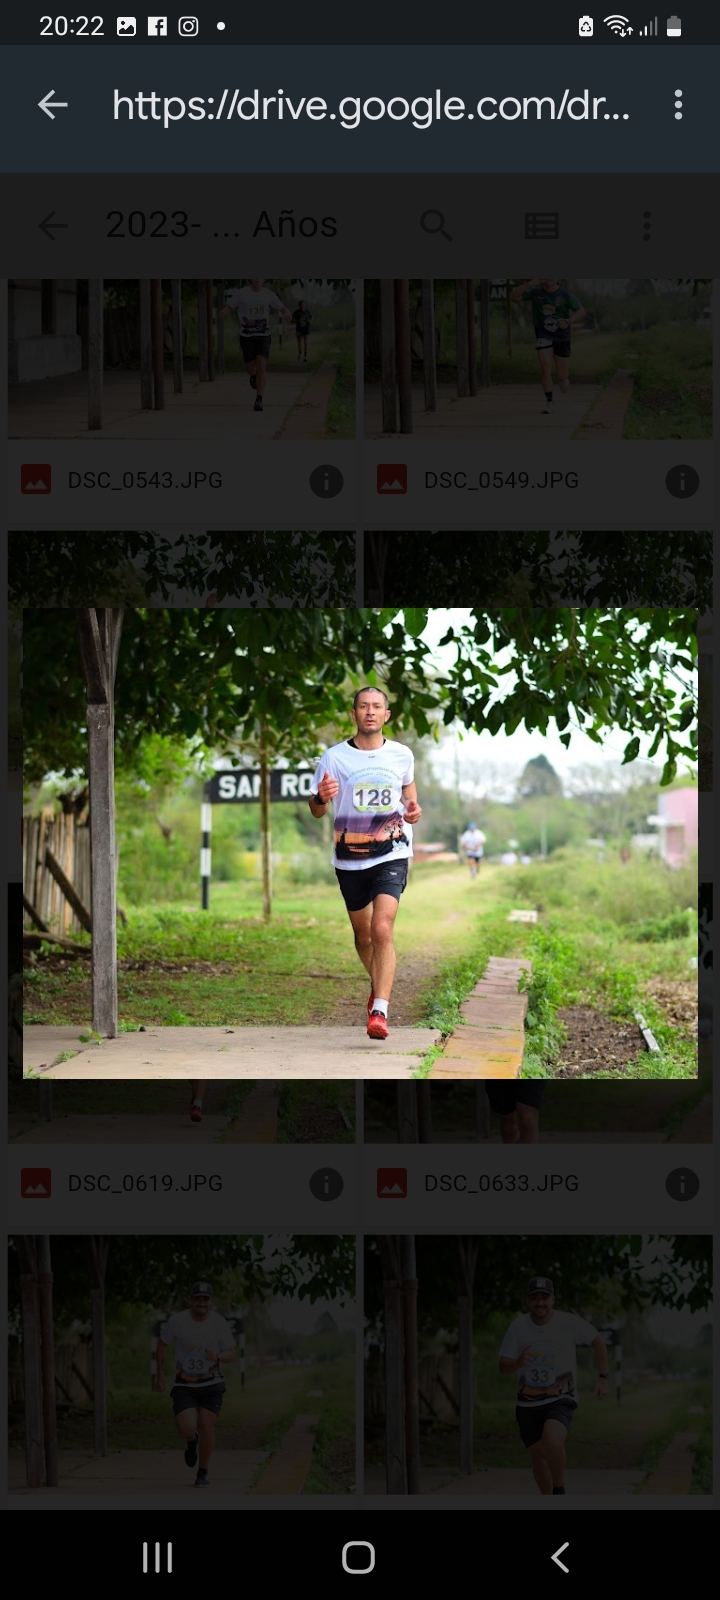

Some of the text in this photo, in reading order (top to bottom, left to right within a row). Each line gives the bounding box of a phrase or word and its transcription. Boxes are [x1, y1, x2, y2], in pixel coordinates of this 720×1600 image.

[40, 16, 104, 36] 20:22
[114, 88, 629, 129] https://drive.google.com/dr...
[107, 211, 201, 238] 2023-
[252, 210, 338, 238] Años
[69, 472, 223, 491] DSC_0543.JPG
[425, 472, 579, 491] DSC_0549.JPG
[355, 789, 391, 806] 128
[69, 1175, 223, 1194] DSC_0619.JPG
[425, 1175, 579, 1194] DSC_0633.JPG
[188, 1359, 204, 1371] 33
[531, 1369, 549, 1383] 33
